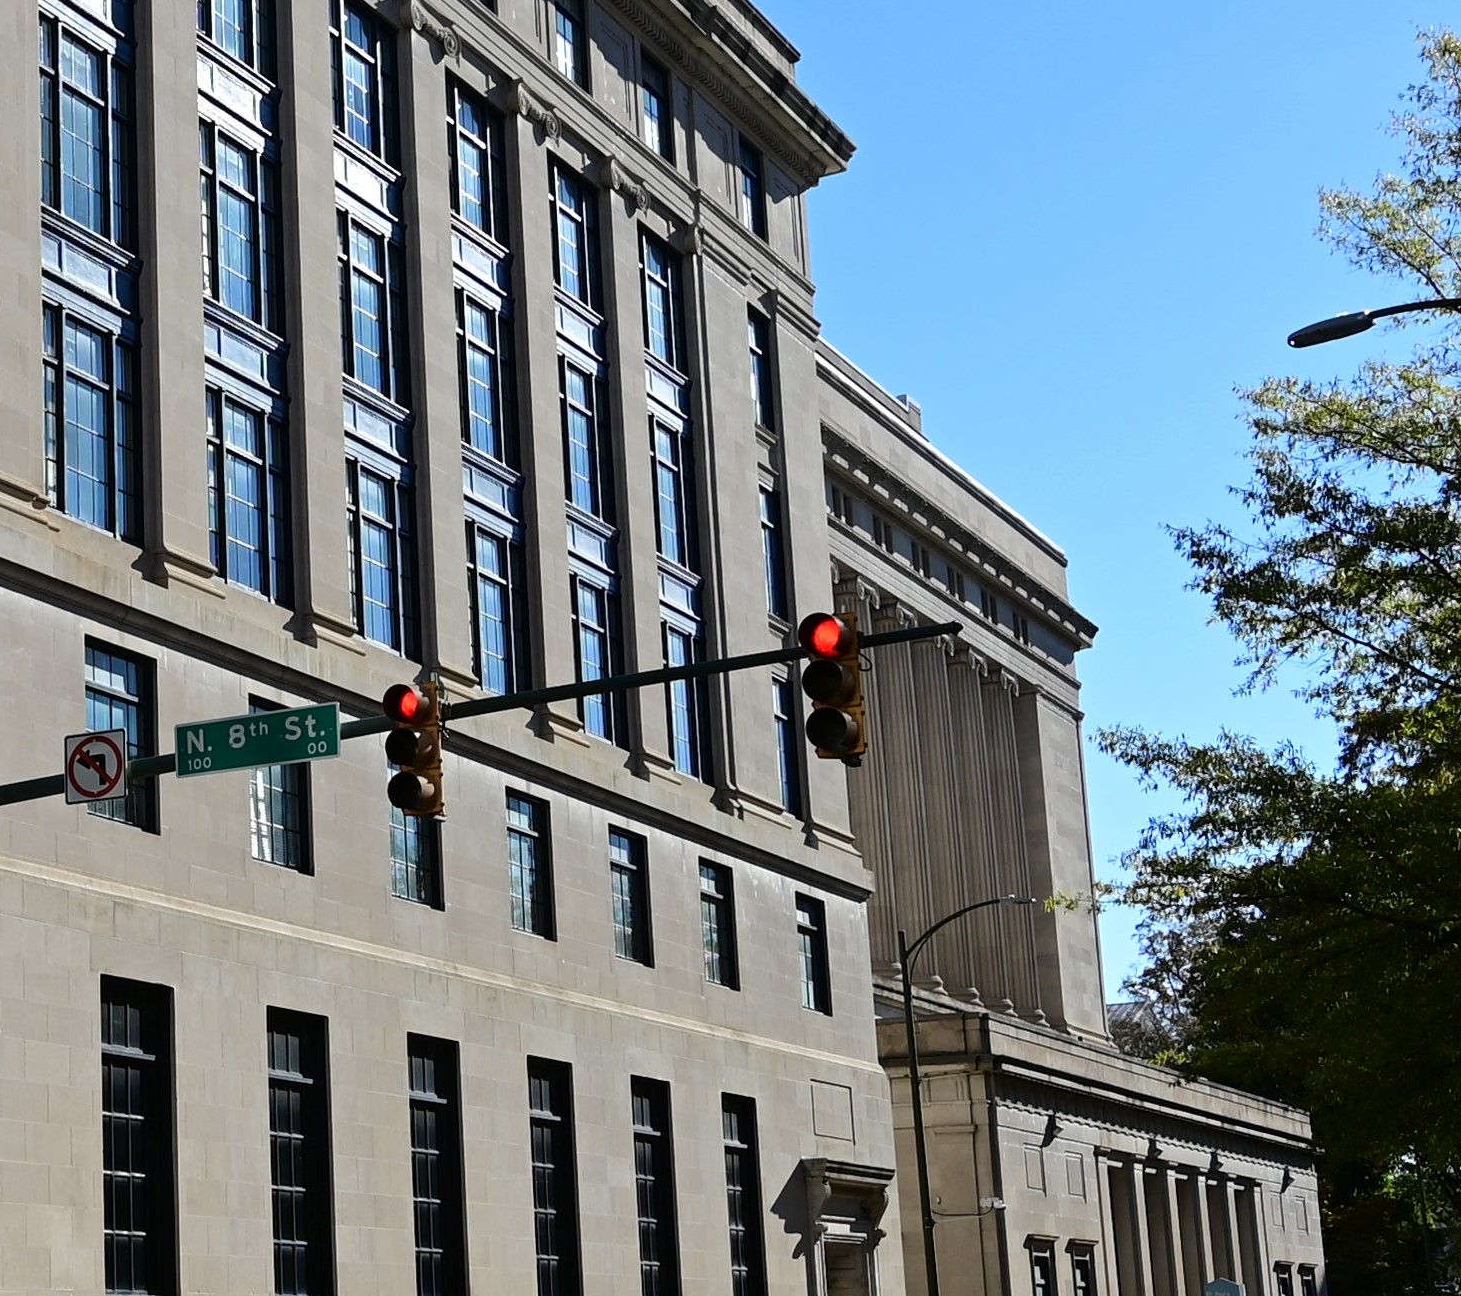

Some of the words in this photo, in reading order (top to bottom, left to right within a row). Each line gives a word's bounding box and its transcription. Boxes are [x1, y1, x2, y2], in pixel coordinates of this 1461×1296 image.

[186, 728, 213, 754] N.
[228, 721, 269, 749] 8th
[284, 713, 326, 741] St.
[307, 740, 327, 755] 00
[187, 756, 212, 771] 100
